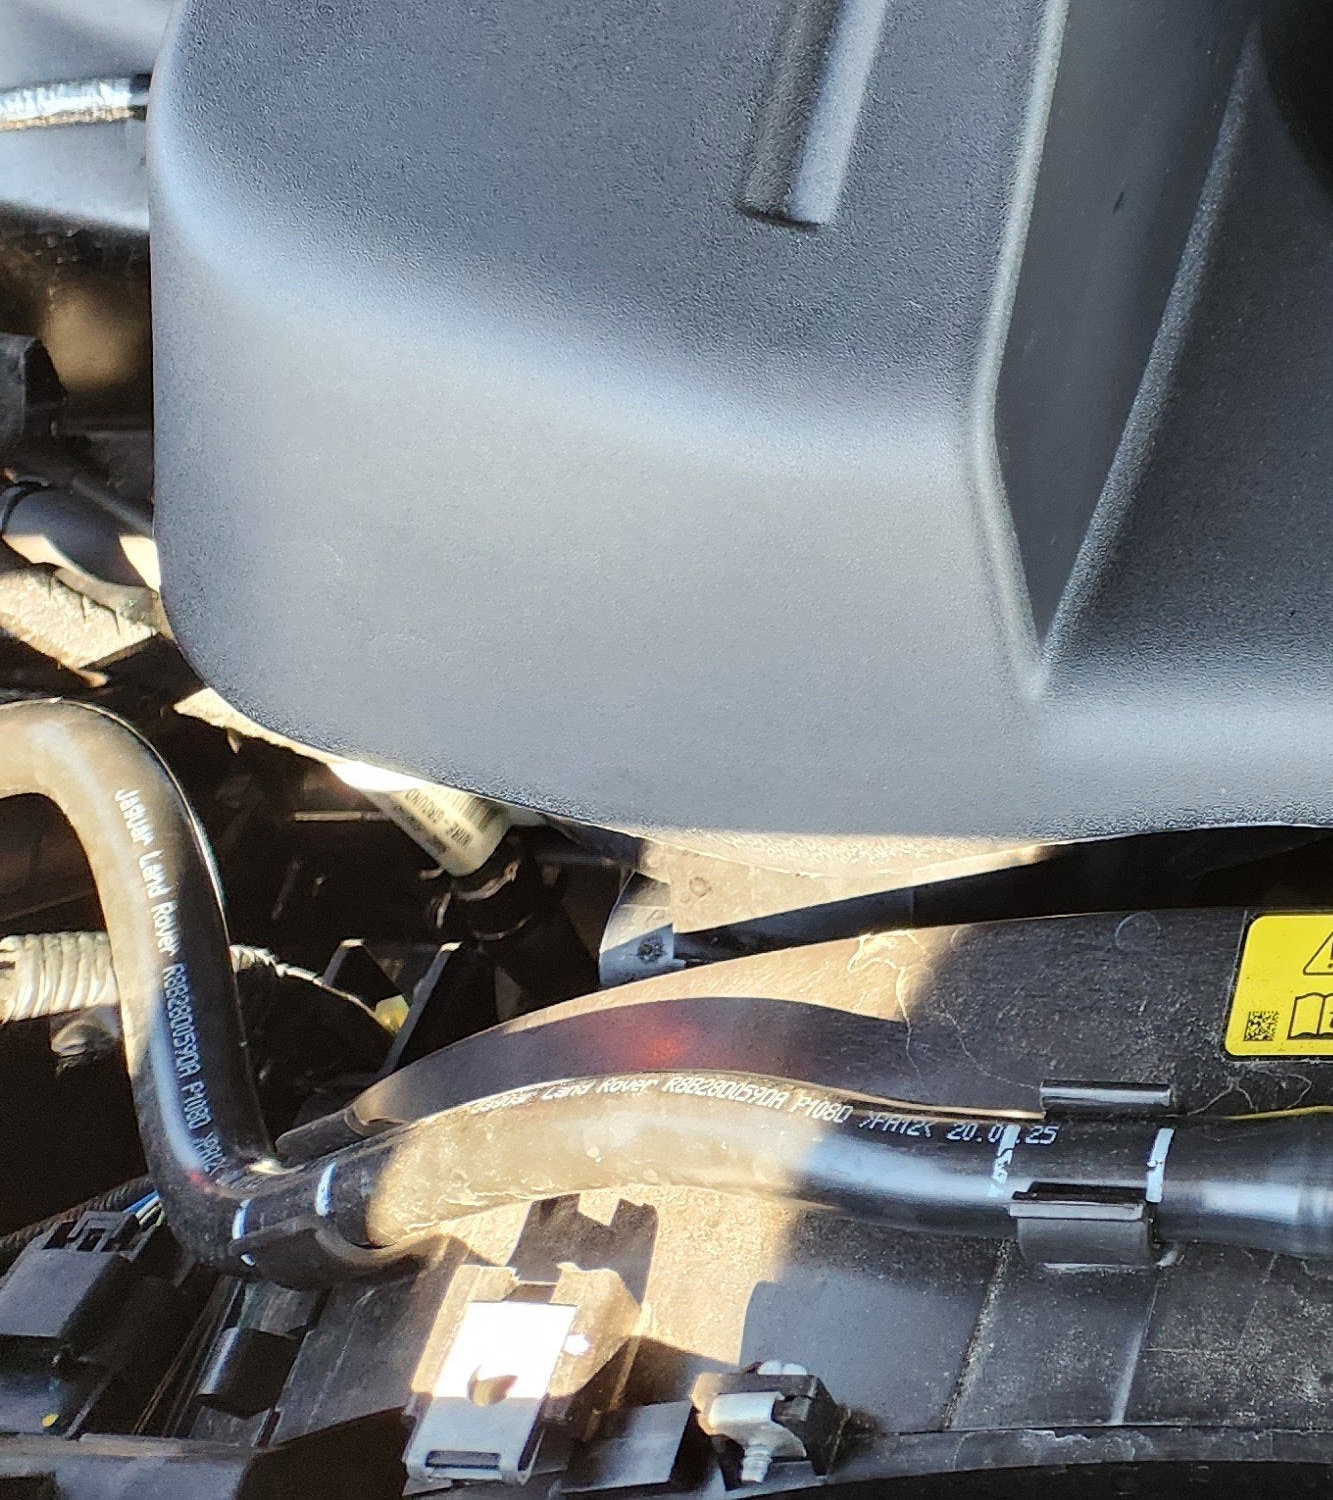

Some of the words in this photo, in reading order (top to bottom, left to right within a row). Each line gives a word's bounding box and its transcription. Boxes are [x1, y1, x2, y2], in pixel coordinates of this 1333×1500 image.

[139, 849, 174, 899] Land
[151, 900, 181, 957] Rover
[946, 1122, 1060, 1145] 20.0.25
